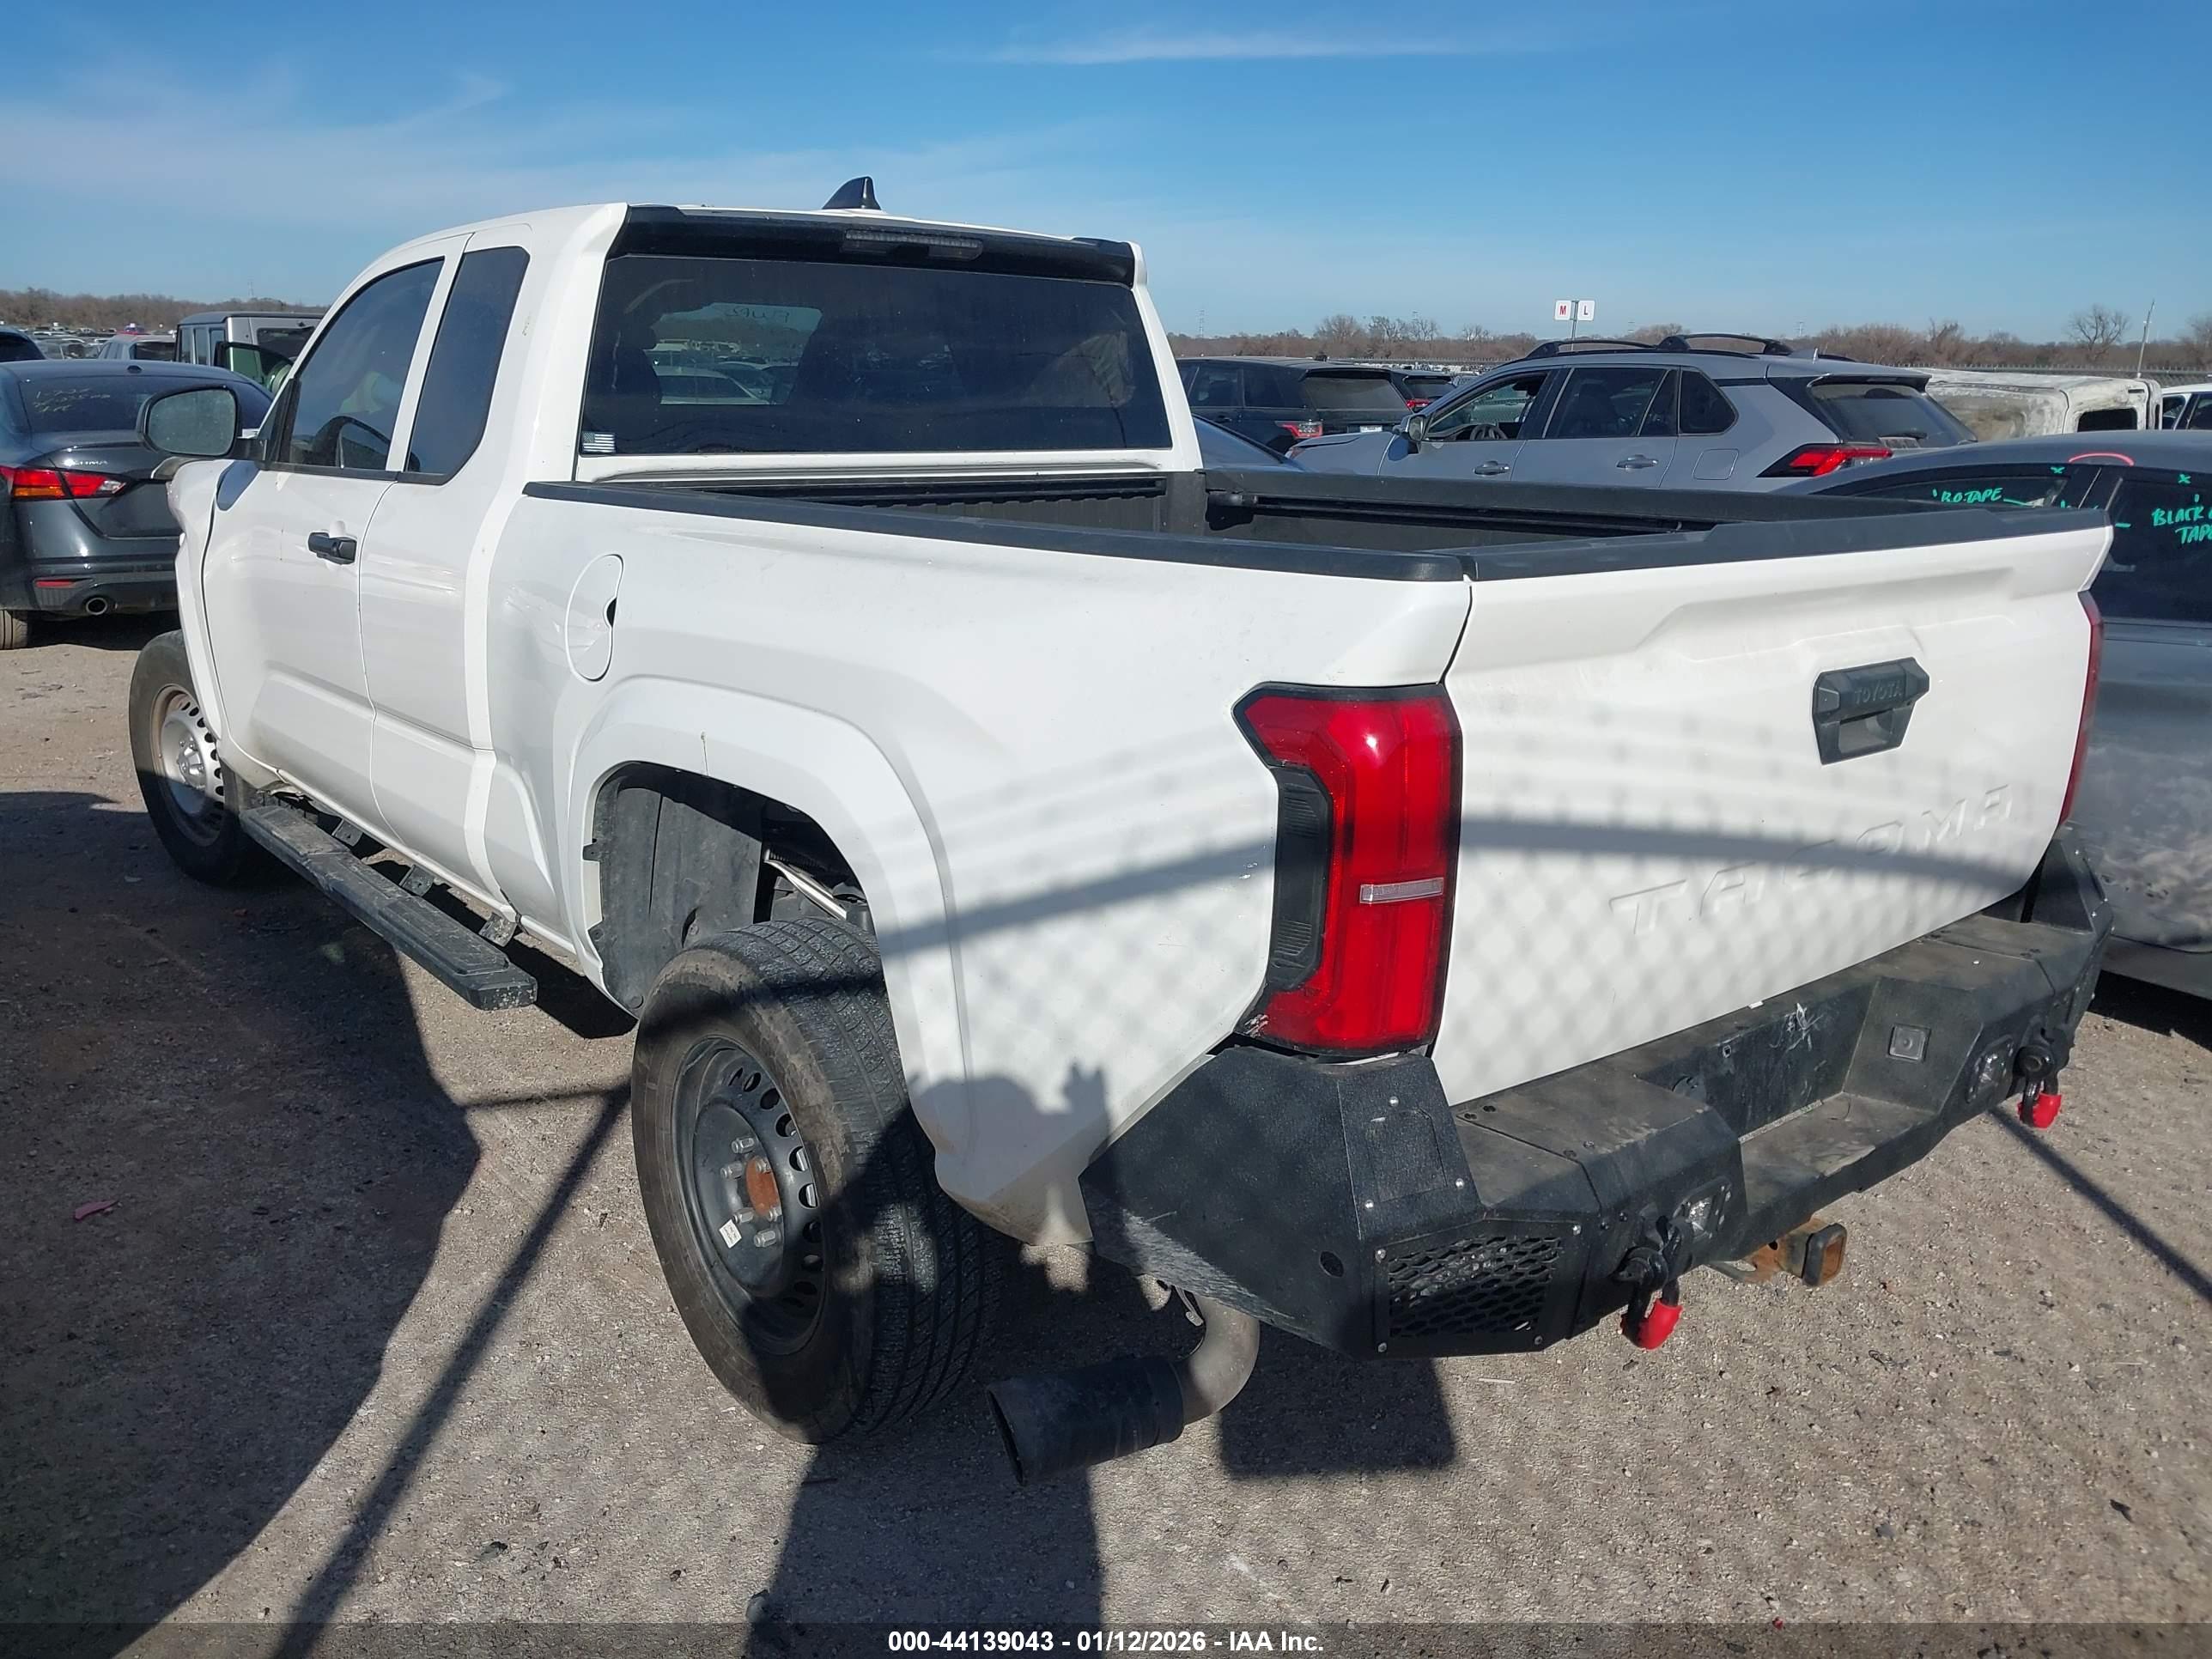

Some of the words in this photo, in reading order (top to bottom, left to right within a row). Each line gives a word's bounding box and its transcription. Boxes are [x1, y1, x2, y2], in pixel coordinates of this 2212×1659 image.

[1559, 305, 1566, 315] M
[1583, 305, 1589, 315] L
[1855, 679, 1902, 704] TOYOTA
[1608, 784, 2014, 935] TACOMA
